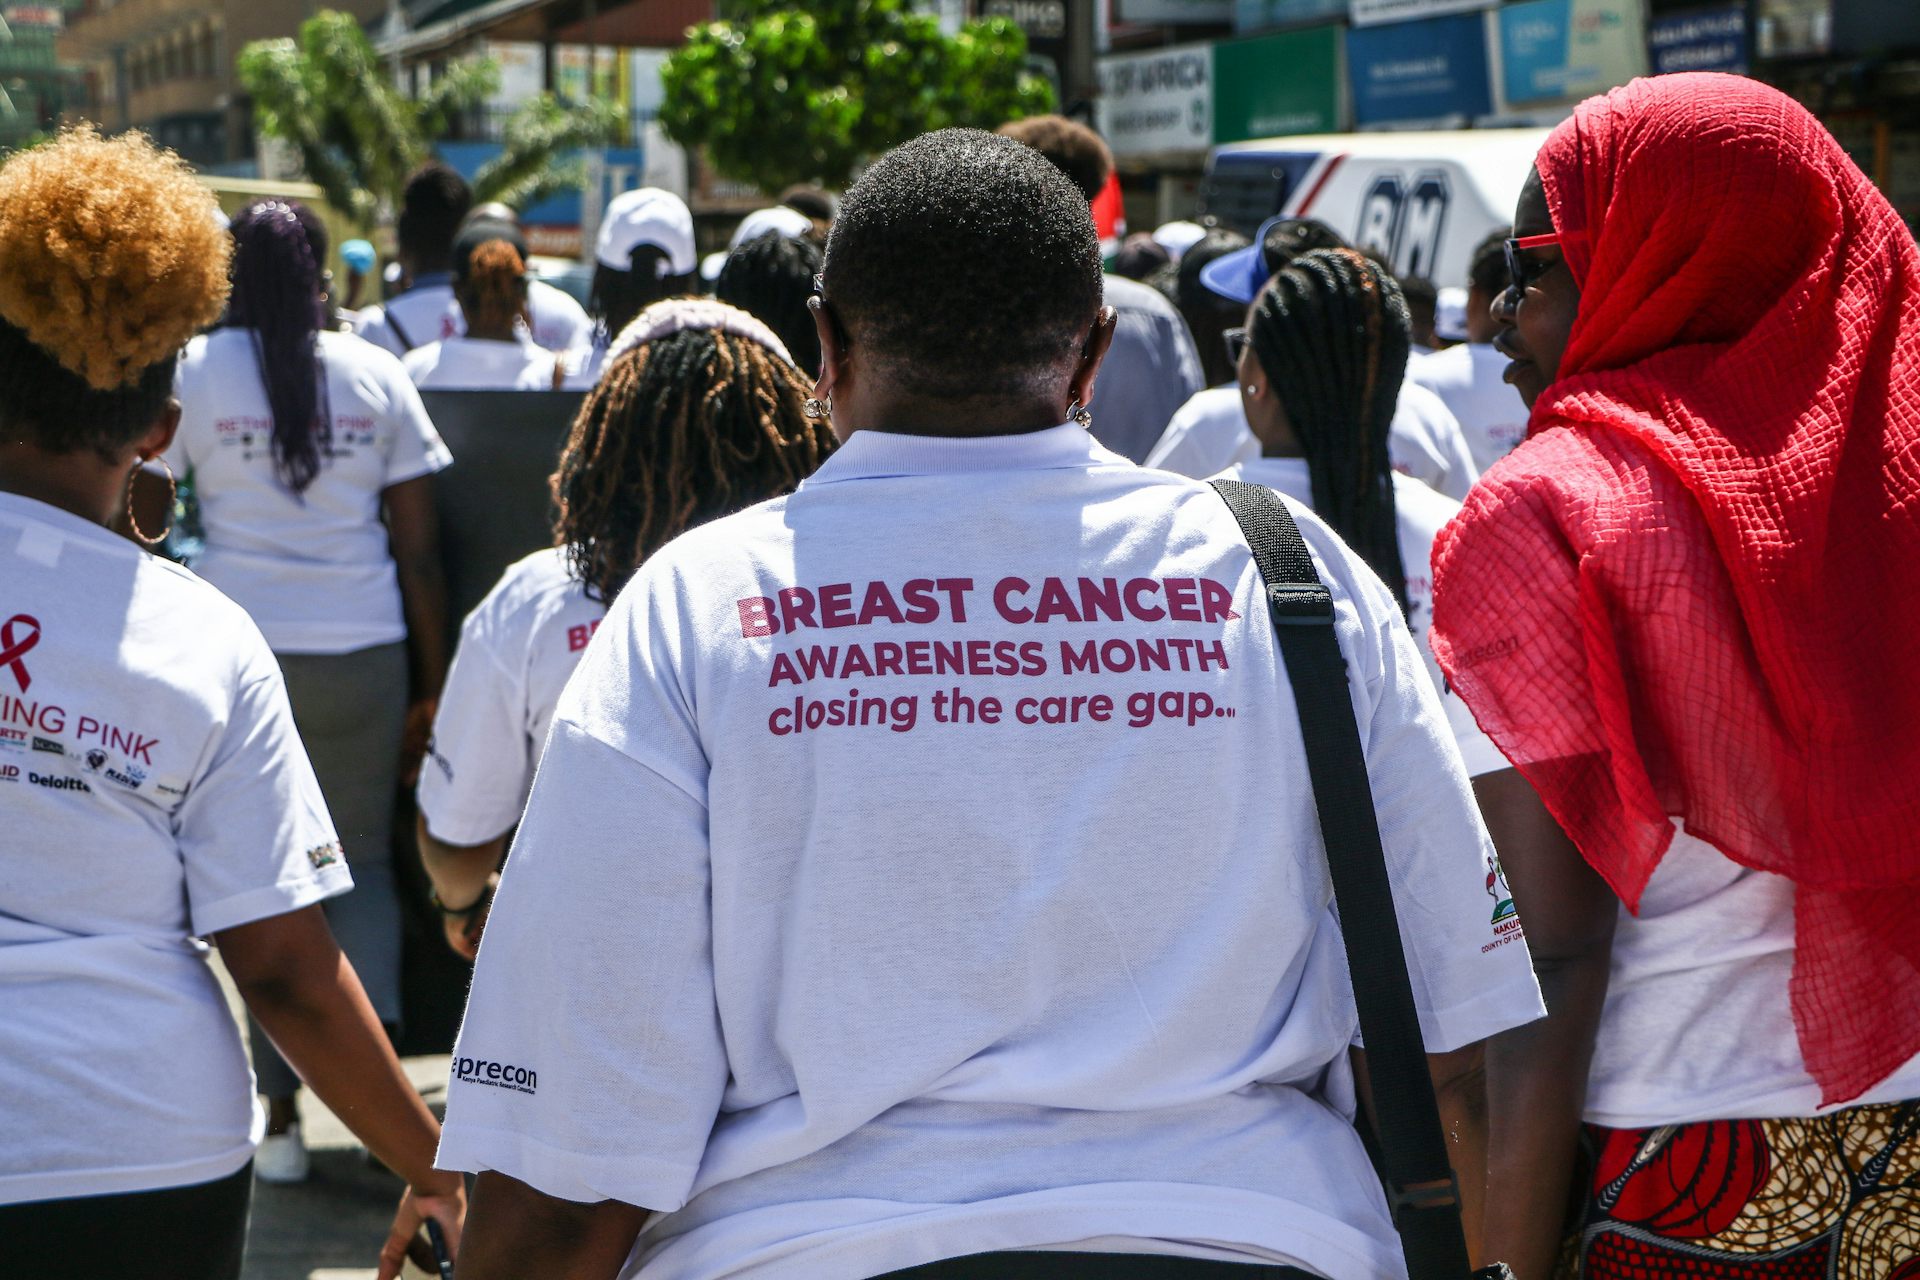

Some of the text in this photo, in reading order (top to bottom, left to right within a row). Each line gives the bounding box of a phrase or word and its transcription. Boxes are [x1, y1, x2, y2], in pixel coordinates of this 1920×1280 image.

[737, 576, 1241, 638] BREAST CANCER
[768, 638, 1230, 688] AWARENESS MONTH
[768, 688, 918, 736] closing
[931, 687, 1003, 724] the
[1015, 693, 1114, 725] care
[76, 715, 160, 767] PINK
[29, 771, 91, 793] Deloitte
[1481, 940, 1503, 953] COUNTY
[1504, 936, 1512, 944] OF
